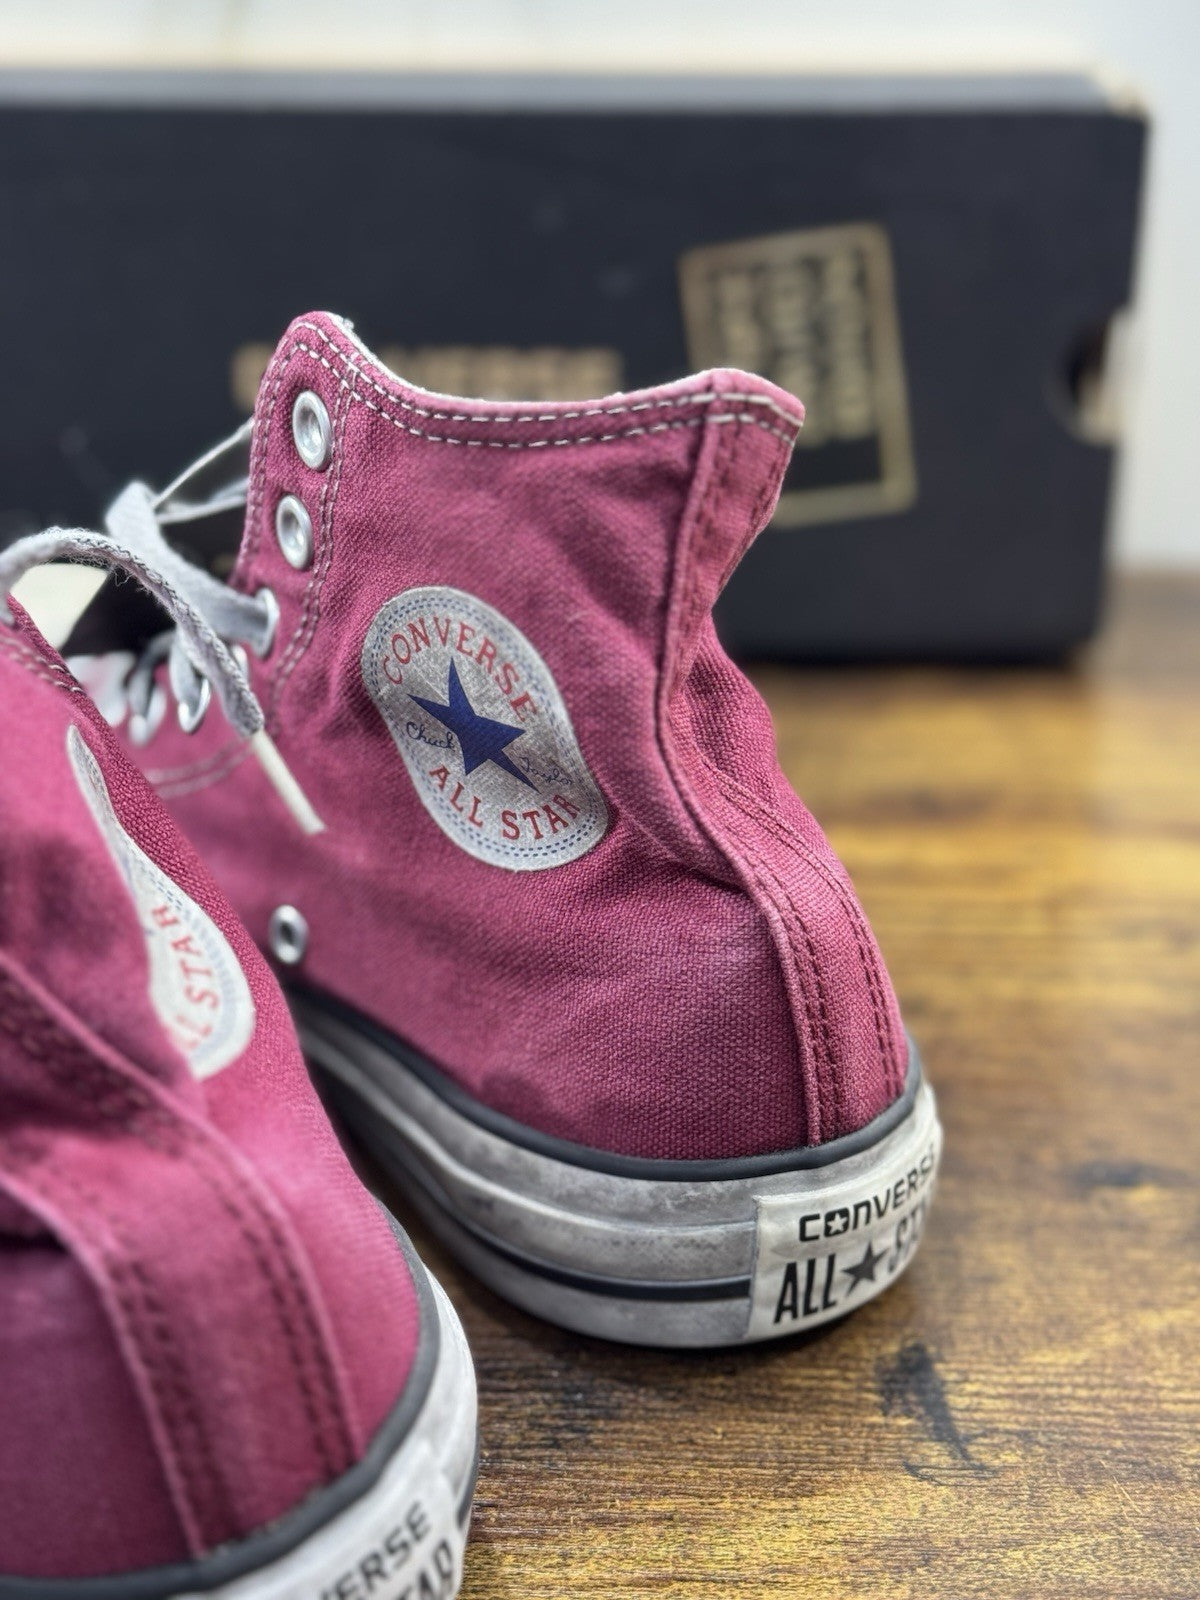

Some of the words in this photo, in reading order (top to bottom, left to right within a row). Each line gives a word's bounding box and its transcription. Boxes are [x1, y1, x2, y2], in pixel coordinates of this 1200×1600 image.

[382, 617, 537, 722] CONVERSE
[406, 721, 456, 752] Chuck
[429, 764, 483, 828] ALL
[502, 794, 581, 841] STAR
[153, 904, 220, 1010] STAR
[773, 1253, 838, 1324] ALL
